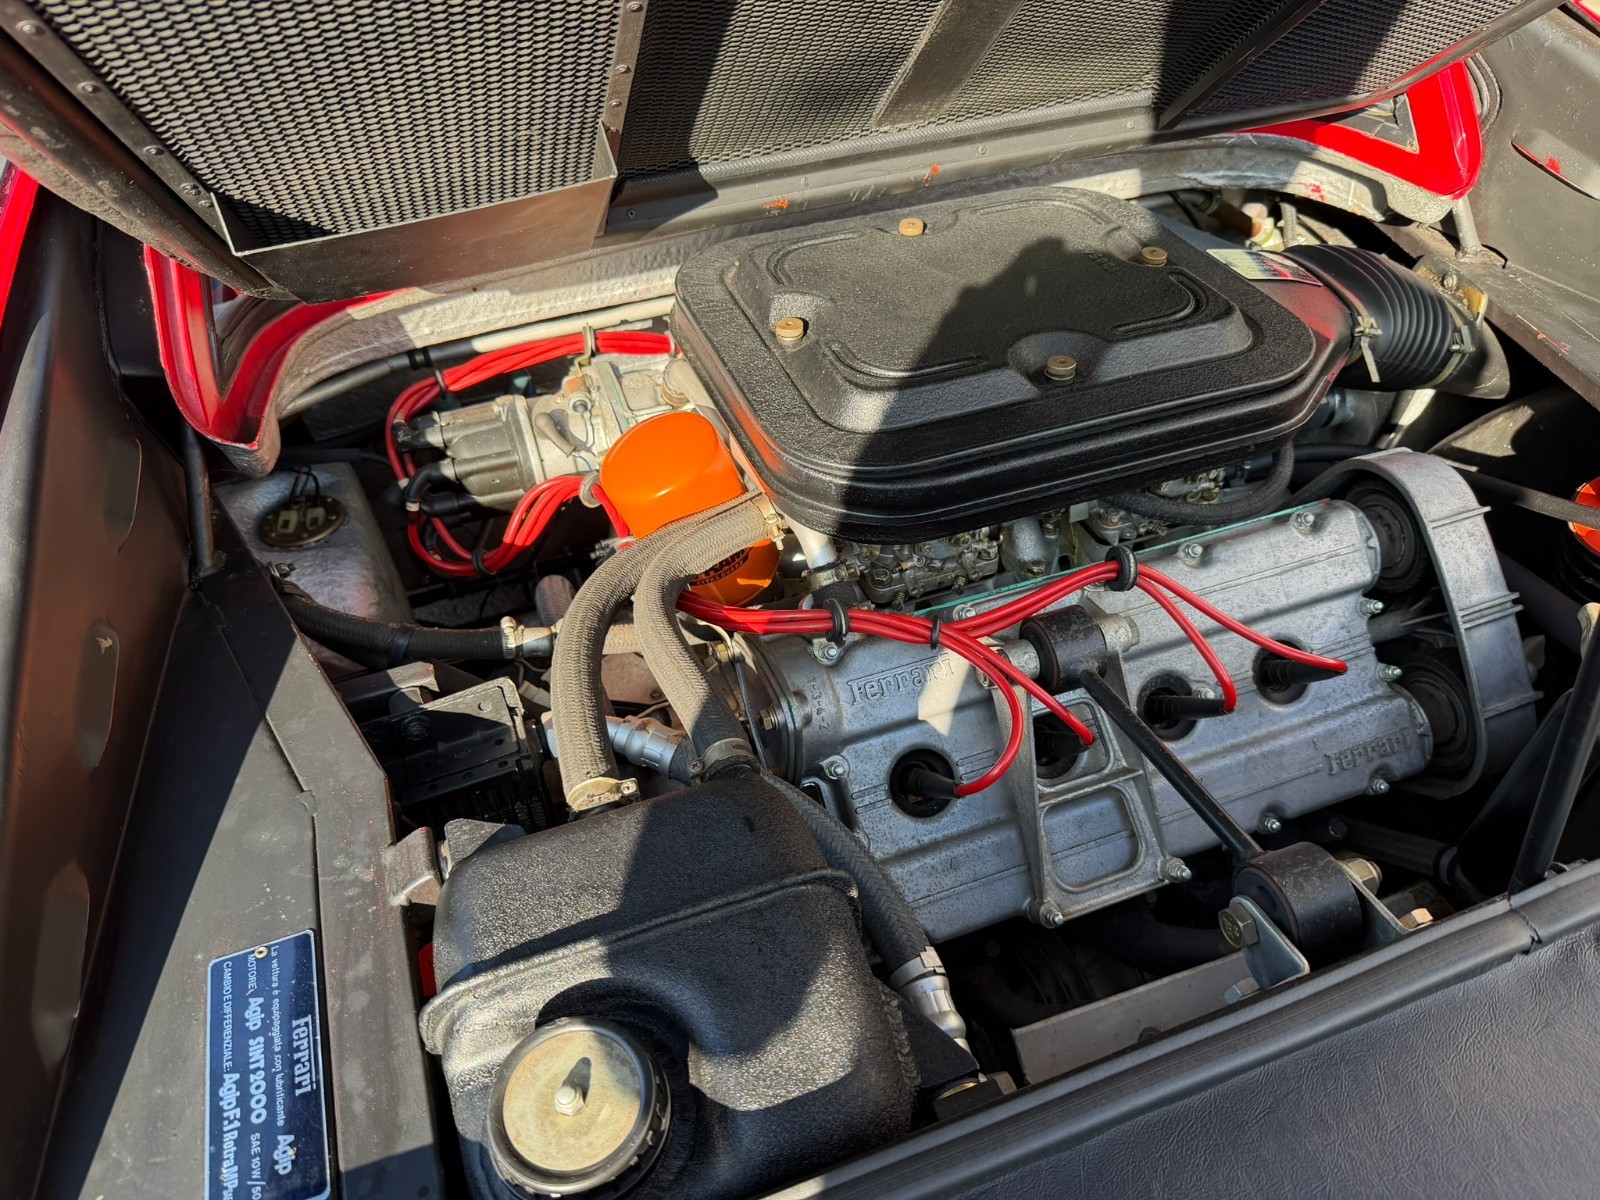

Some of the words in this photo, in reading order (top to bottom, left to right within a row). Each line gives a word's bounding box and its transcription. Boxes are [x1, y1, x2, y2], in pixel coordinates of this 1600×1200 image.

[720, 559, 745, 579] GUARD
[847, 653, 954, 706] Ferrari
[1324, 727, 1412, 776] Ferrari
[270, 945, 280, 957] La
[223, 961, 233, 994] CAMBIO
[271, 958, 281, 988] vettura
[244, 997, 265, 1031] Agip
[271, 998, 282, 1052] equipaggiata
[223, 1002, 234, 1072] DIFFERENZIALE:
[275, 1055, 284, 1072] con
[291, 1014, 317, 1097] Ferrari
[218, 1073, 241, 1109] Agip
[275, 1073, 286, 1127] lubrificante
[251, 1132, 261, 1156] SAE
[273, 1134, 296, 1176] Agip
